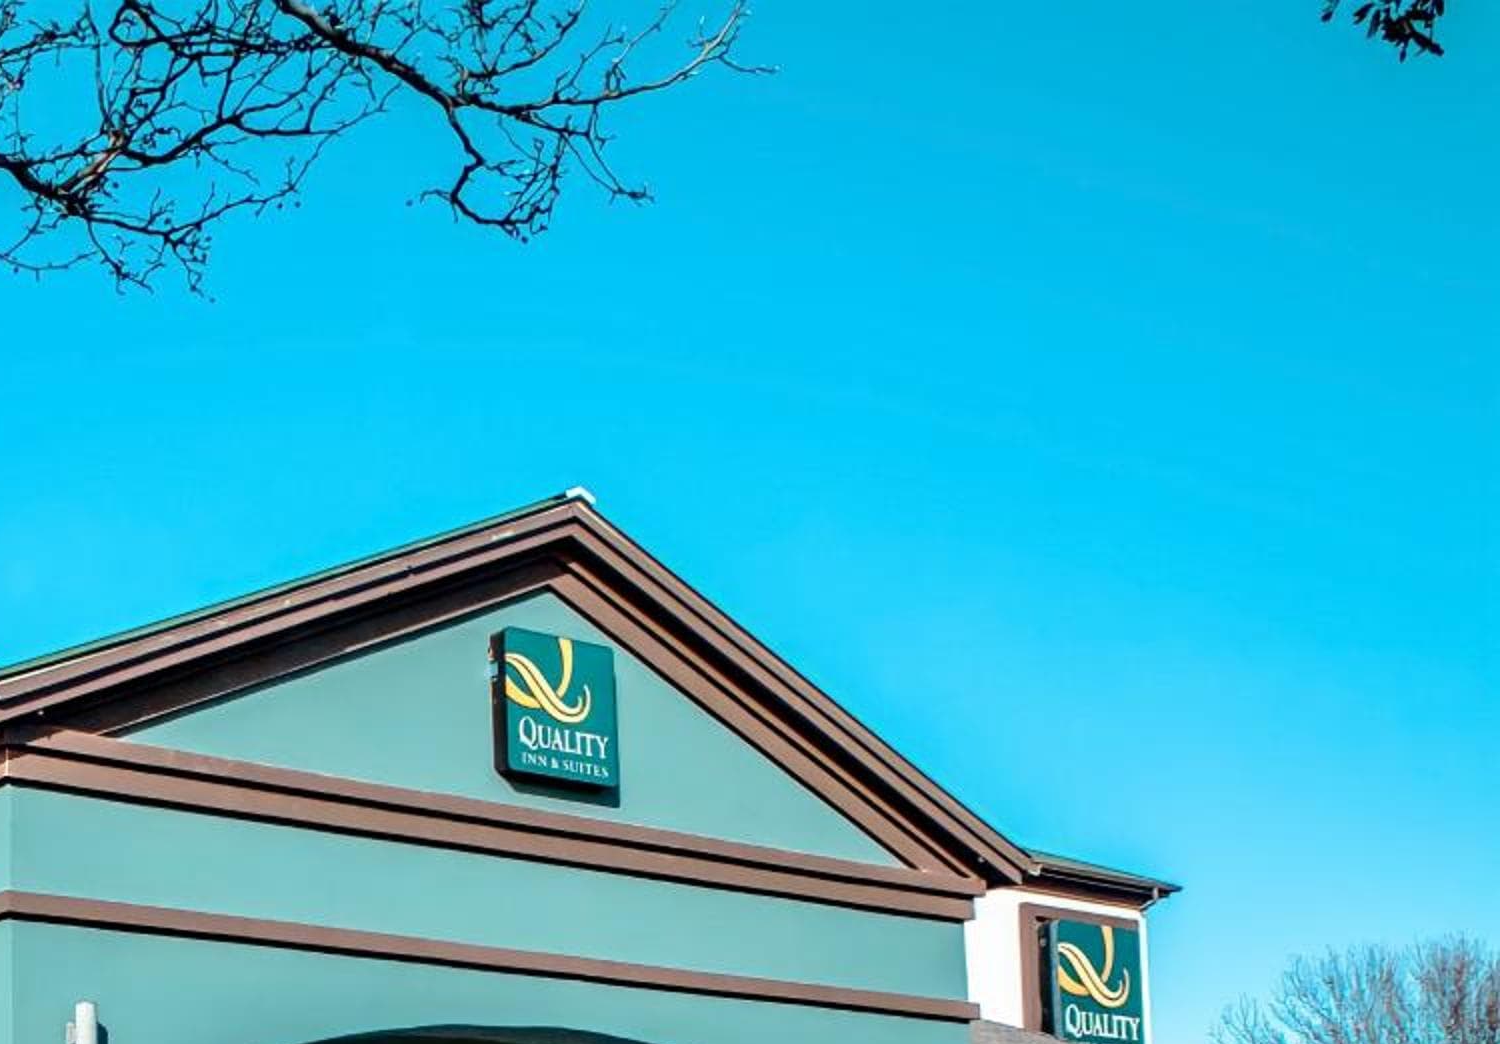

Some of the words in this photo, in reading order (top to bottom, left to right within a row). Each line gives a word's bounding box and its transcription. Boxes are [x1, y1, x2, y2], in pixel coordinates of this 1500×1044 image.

[519, 716, 608, 759] QUALITY
[522, 752, 547, 766] INN
[551, 757, 559, 769] &
[563, 760, 609, 777] SUITES
[1066, 1004, 1140, 1040] QUALITY
